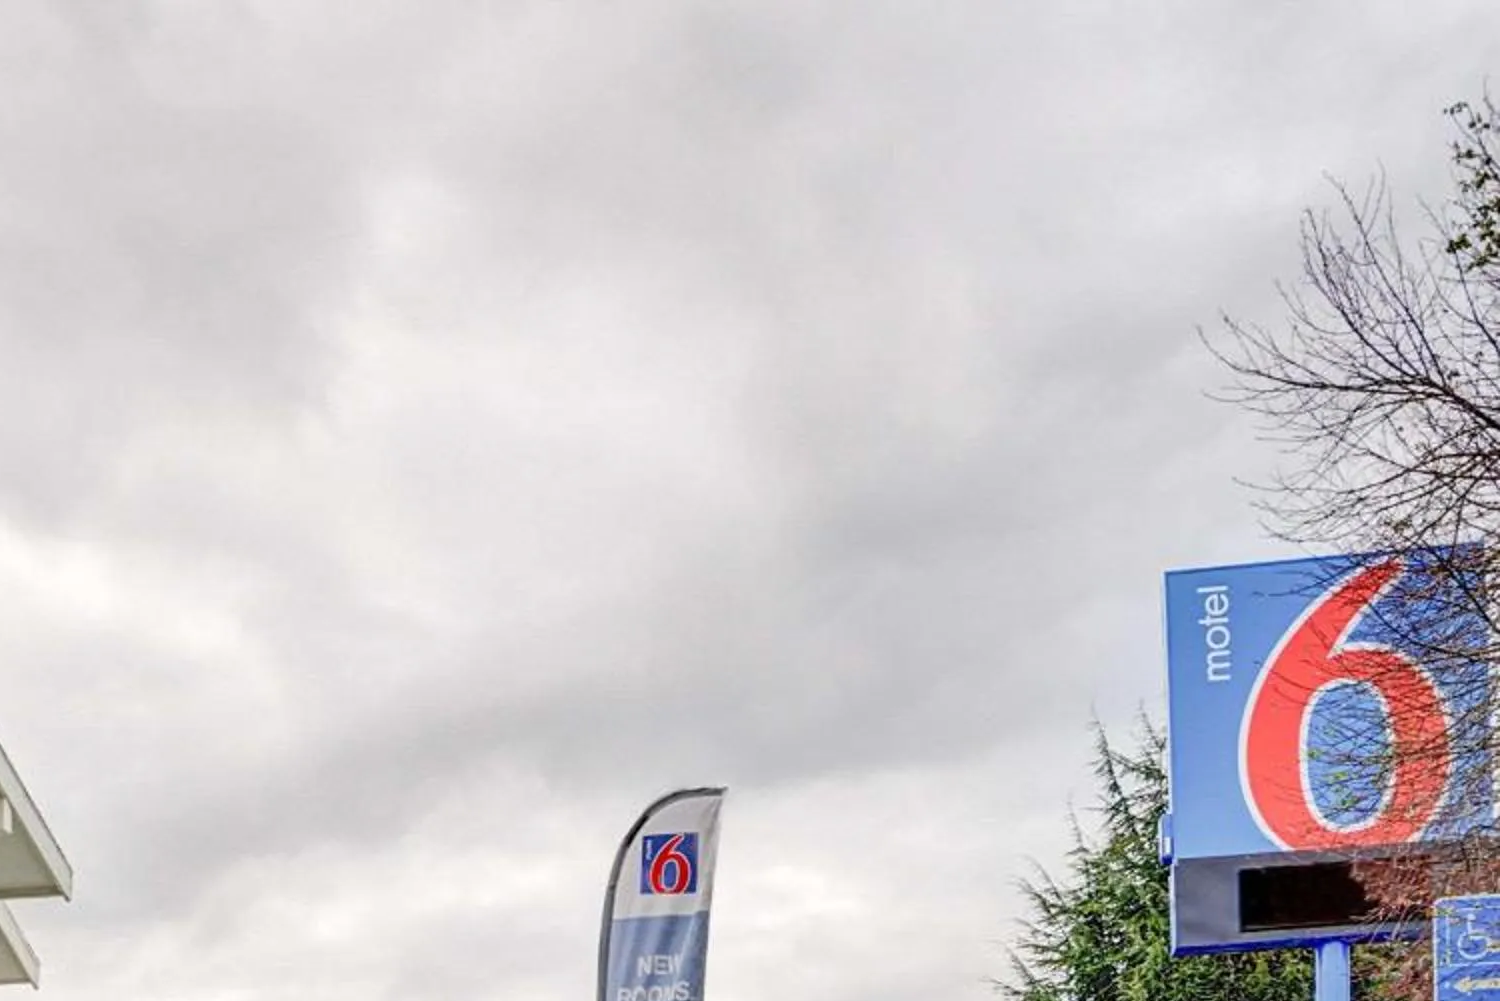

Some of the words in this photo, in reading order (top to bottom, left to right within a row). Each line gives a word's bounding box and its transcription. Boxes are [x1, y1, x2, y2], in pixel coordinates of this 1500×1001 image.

[1196, 585, 1231, 682] motel
[1238, 553, 1453, 850] 6
[649, 833, 691, 897] 6
